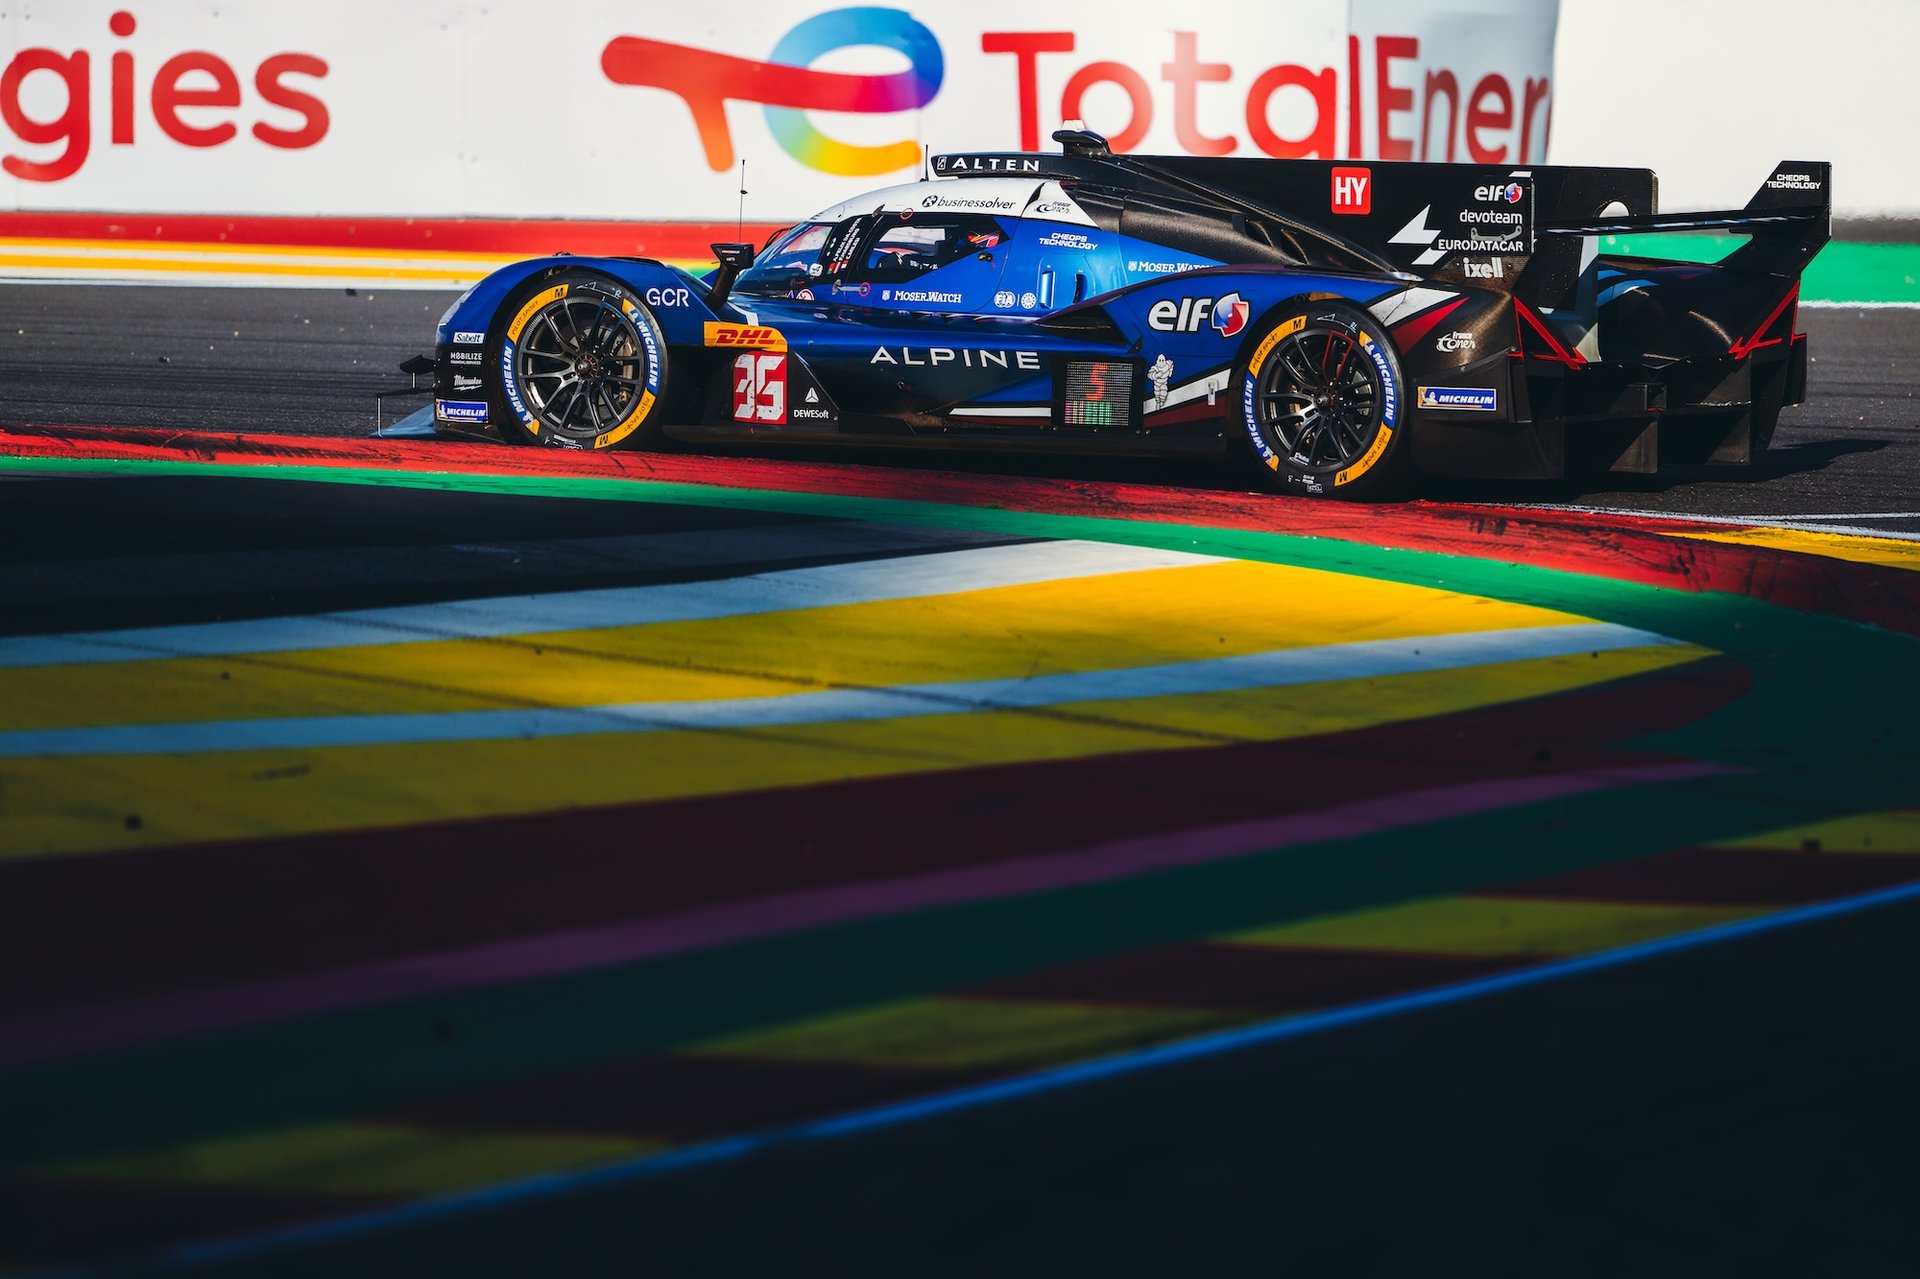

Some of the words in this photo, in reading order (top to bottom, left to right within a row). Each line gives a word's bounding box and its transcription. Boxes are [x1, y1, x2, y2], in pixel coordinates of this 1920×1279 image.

[0, 10, 330, 182] gies
[980, 29, 1552, 166] TotalEner
[952, 157, 1040, 172] ALTEN
[1776, 173, 1810, 182] CHEOPS
[1335, 176, 1367, 206] HY
[1474, 185, 1504, 201] elf
[1766, 181, 1821, 190] TECHNOLOGY
[937, 196, 1016, 210] businessolver
[1459, 209, 1523, 224] devoteam
[1039, 237, 1098, 250] TECHNOLOGY
[1051, 232, 1088, 242] CHEOPS
[1438, 238, 1523, 252] EURODATACAR
[1463, 257, 1503, 279] ixell
[554, 287, 564, 299] M
[646, 288, 689, 307] GCR
[894, 290, 962, 303] MOSER.WATCH
[995, 293, 1014, 305] FIA
[1148, 298, 1212, 332] elf
[1293, 319, 1302, 331] M
[456, 333, 480, 342] Sabelt
[716, 329, 776, 344] DHL
[636, 321, 658, 387] MICHELIN
[870, 346, 1041, 370] ALPINE
[504, 345, 525, 413] MICHELIN
[1372, 352, 1396, 420] MICHELIN
[734, 354, 785, 420] 35
[1439, 394, 1493, 404] MICHELIN
[447, 407, 485, 416] MICHELIN
[794, 409, 829, 419] DEWESoft
[1244, 379, 1265, 449] MICHELIN
